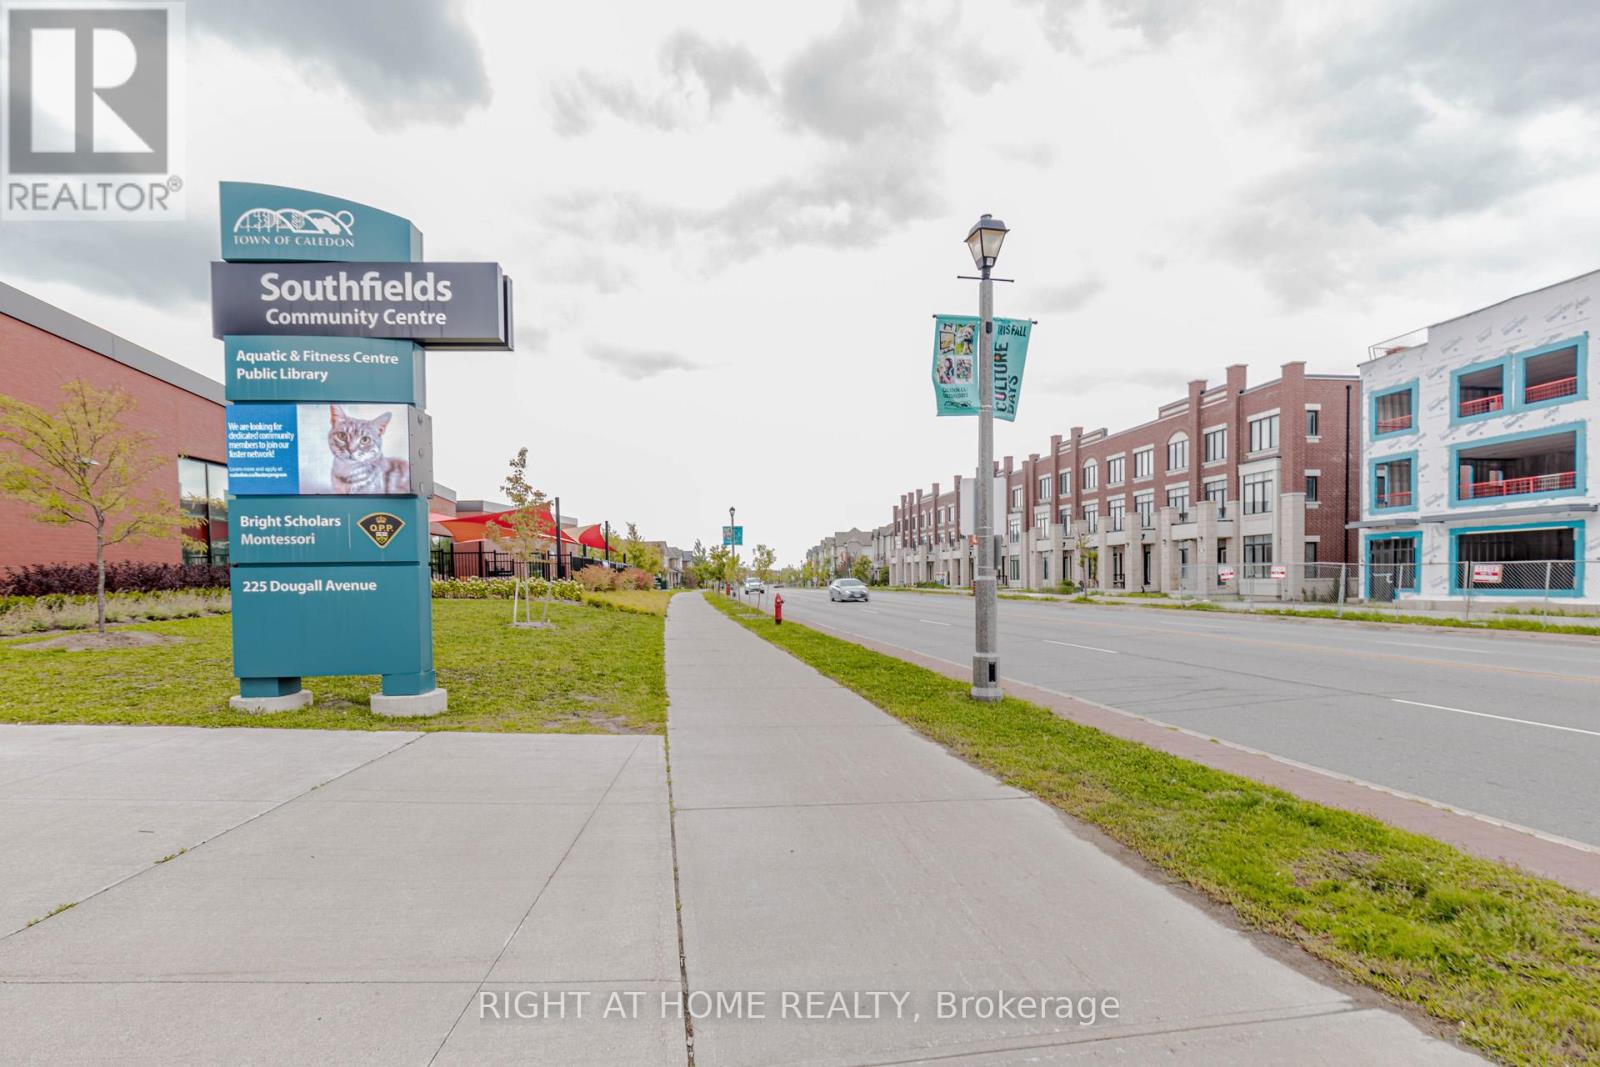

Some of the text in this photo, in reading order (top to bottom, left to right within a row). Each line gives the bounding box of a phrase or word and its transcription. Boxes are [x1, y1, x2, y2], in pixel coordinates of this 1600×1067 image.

[233, 235, 355, 248] TOWN OF CALEDON
[260, 271, 453, 302] Southfields
[265, 308, 448, 329] Community Centre
[1011, 325, 1026, 336] FALL
[236, 349, 399, 365] Aquatic & Fitness Centre
[236, 367, 329, 383] Public Library
[994, 342, 1008, 412] CULTURE
[1007, 375, 1018, 415] DAYS
[228, 422, 239, 431] We
[250, 422, 272, 432] looking
[273, 422, 282, 431] for
[229, 432, 294, 441] dedicated community
[229, 441, 258, 449] members
[259, 441, 266, 449] to
[266, 441, 278, 451] join
[240, 514, 342, 530] Bright Scholars
[241, 532, 316, 545] Montessori
[242, 579, 377, 595] 225 Dougall Avenue
